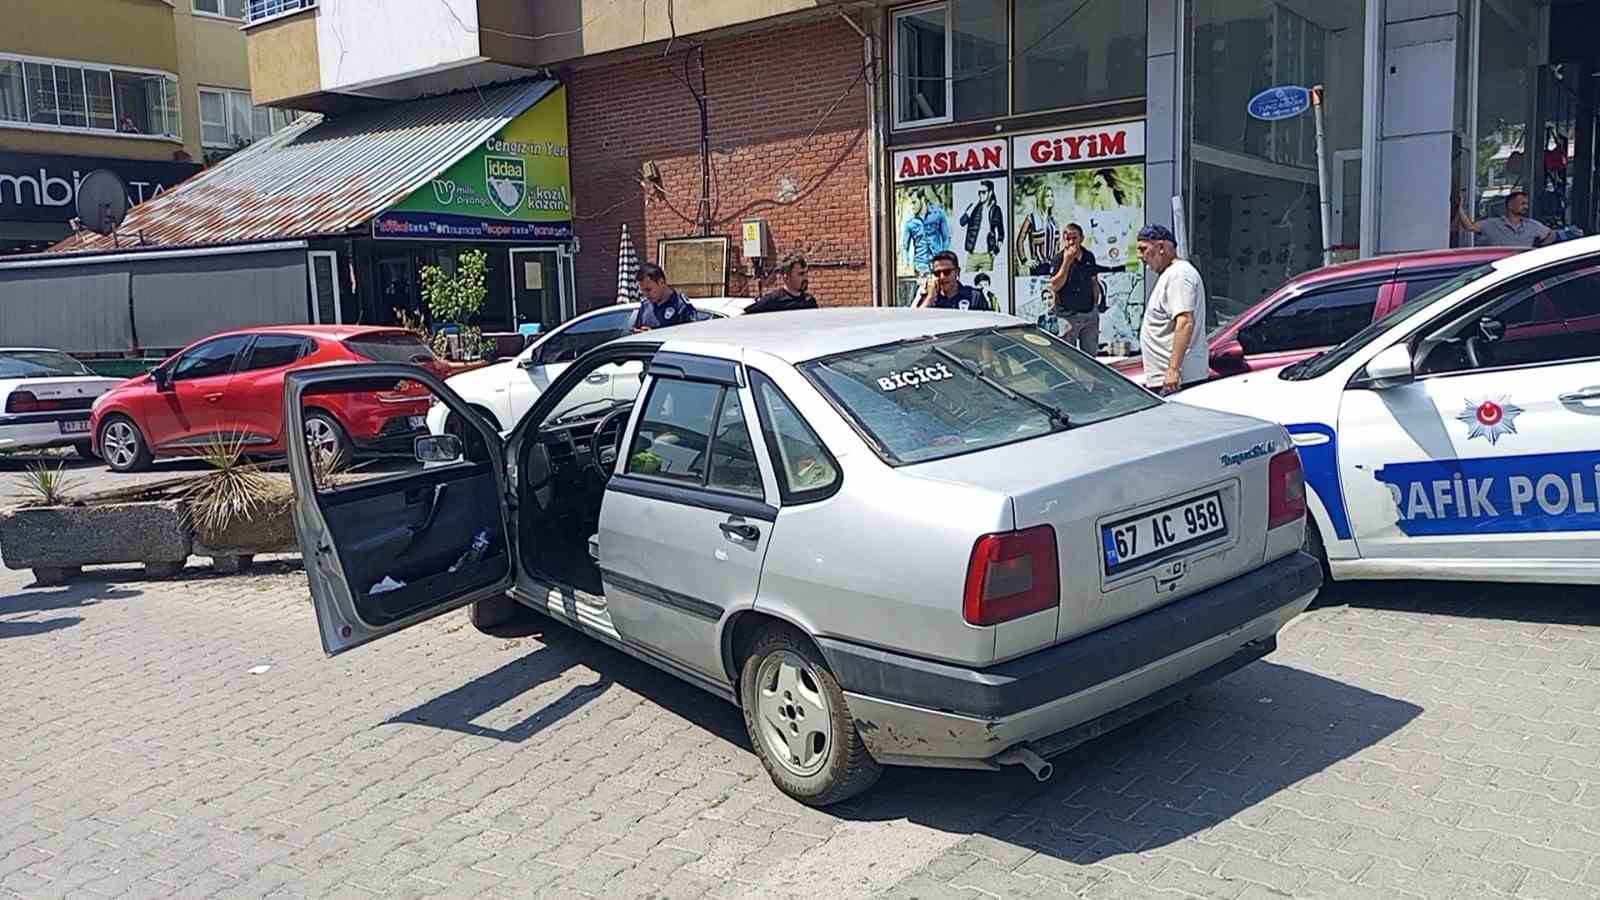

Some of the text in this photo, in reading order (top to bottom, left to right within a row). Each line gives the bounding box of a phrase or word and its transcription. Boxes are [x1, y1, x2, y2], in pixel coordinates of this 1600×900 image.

[488, 159, 522, 177] iddaa
[899, 146, 1002, 178] ARSLAN
[1114, 501, 1220, 558] 67 AC 958
